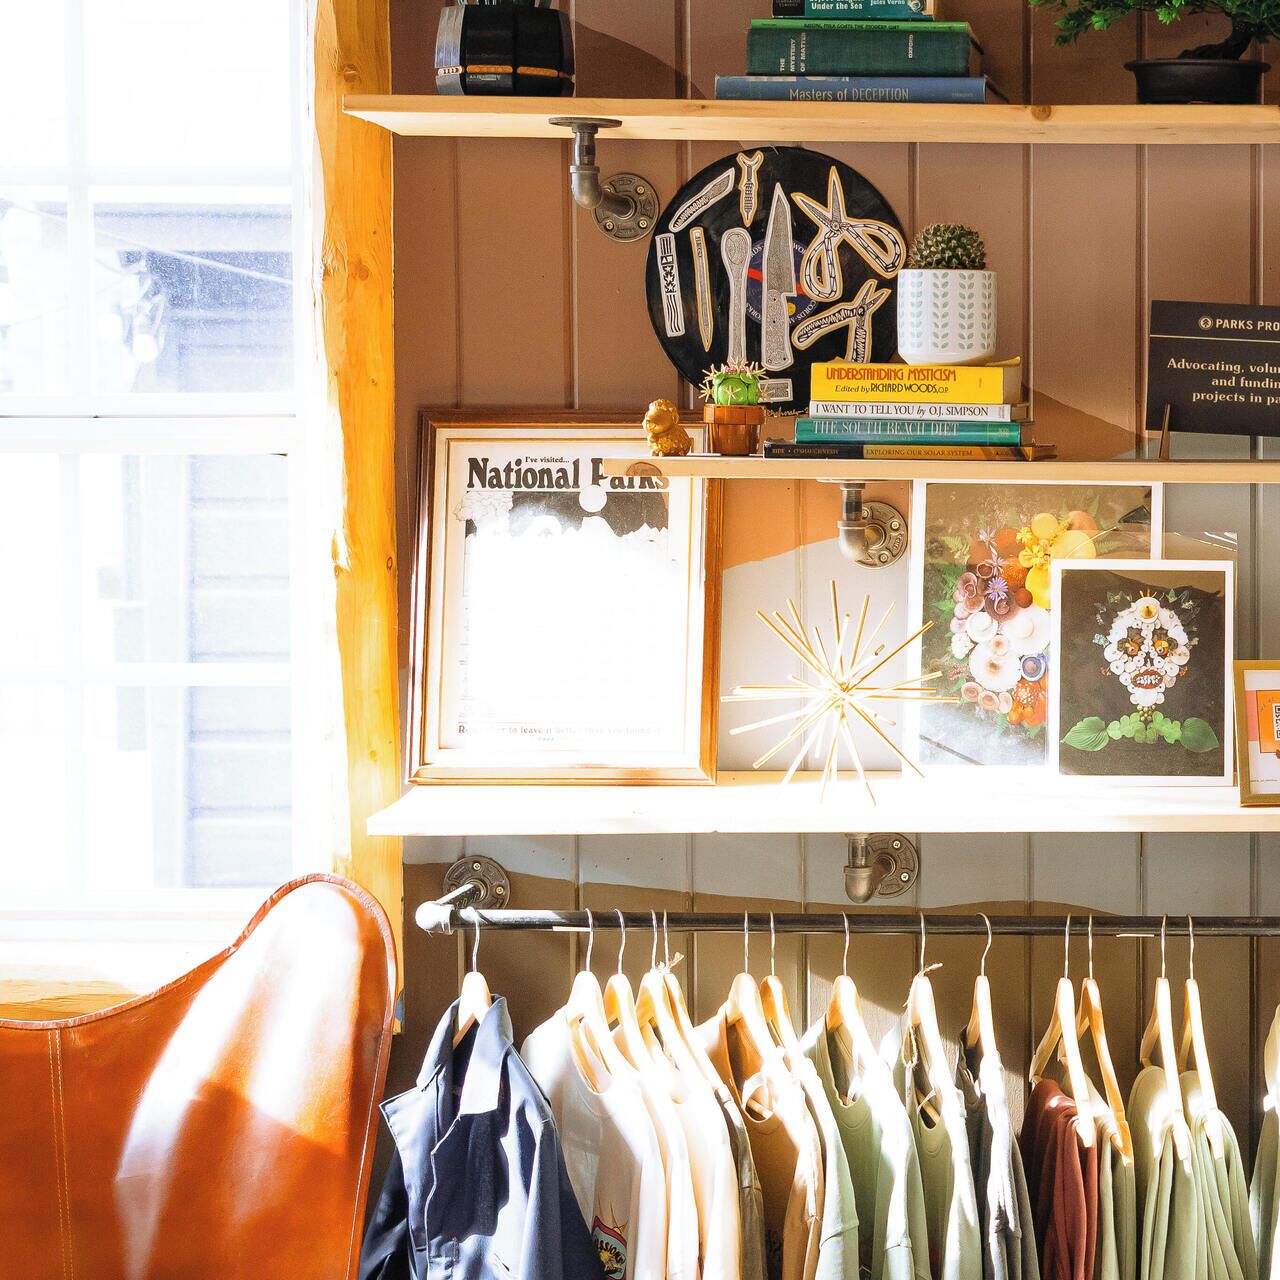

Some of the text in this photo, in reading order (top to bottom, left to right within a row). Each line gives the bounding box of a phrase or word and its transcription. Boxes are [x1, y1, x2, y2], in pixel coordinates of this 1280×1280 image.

[811, 2, 863, 10] Under the Sea
[800, 63, 806, 72] OF
[789, 88, 909, 101] Masters of DECEPTION
[1215, 318, 1254, 330] PARKS
[1167, 357, 1245, 374] Advocating,
[826, 367, 957, 382] UNDERSTANDING MYSTICISM
[1211, 376, 1236, 387] and
[835, 384, 859, 393] Edited
[860, 385, 870, 394] by
[870, 383, 904, 393] RICHARD
[1192, 391, 1246, 403] projects
[1250, 393, 1263, 402] in
[816, 404, 819, 413] I
[821, 404, 851, 414] WANT
[852, 404, 867, 414] TO
[869, 405, 893, 415] TELL
[893, 405, 915, 415] YOU
[916, 405, 926, 416] by
[929, 406, 943, 415] O.J.
[944, 406, 989, 416] SIMPSON
[813, 421, 960, 436] THE SOUTH BEACH DIET
[466, 457, 580, 489] National
